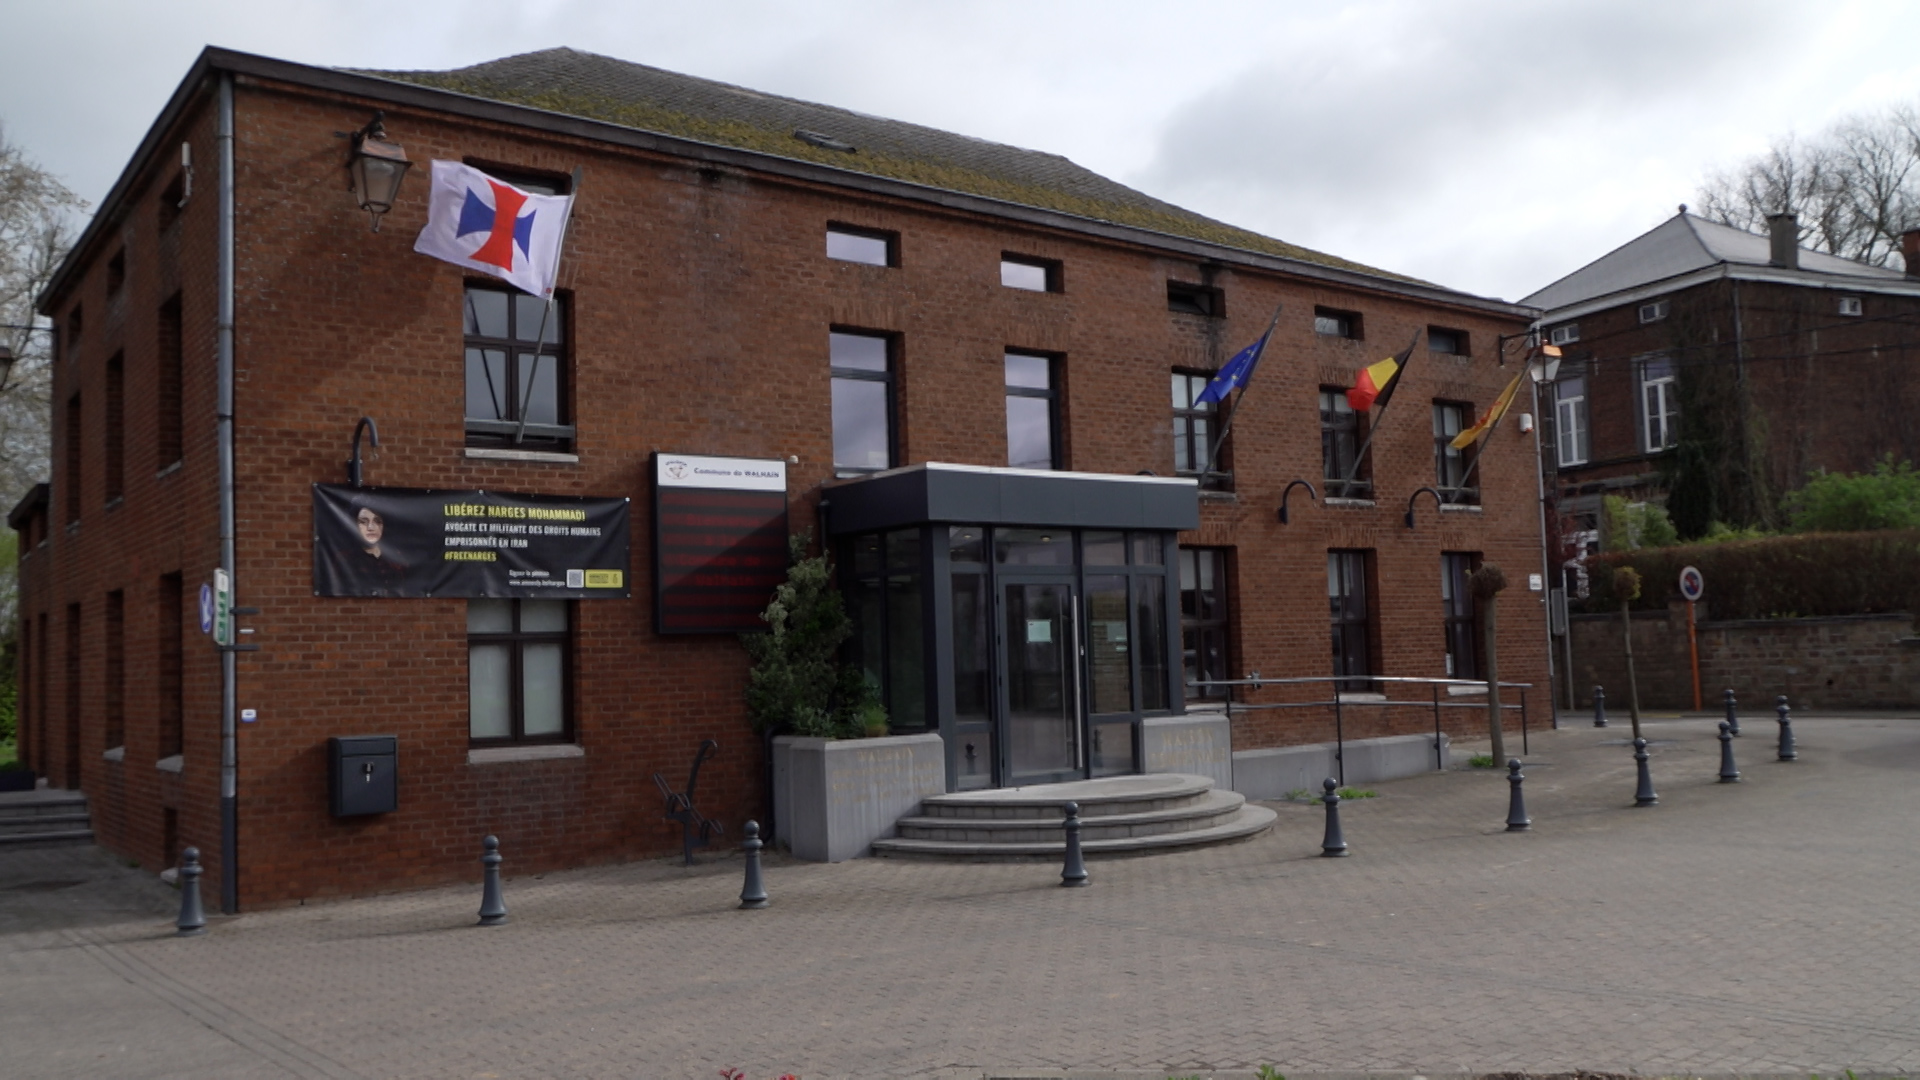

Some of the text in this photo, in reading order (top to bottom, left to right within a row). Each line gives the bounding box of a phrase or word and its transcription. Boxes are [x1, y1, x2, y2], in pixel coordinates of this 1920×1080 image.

[694, 467, 731, 476] Commune
[745, 470, 779, 478] WALHAIN
[444, 502, 586, 521] LIBÉREZ NARGES MOHAMMADI
[444, 522, 601, 536] AVOCATE ET MILITANTE DES DROITS HUMAINS
[444, 535, 528, 548] EMPRISONNÉE EN IRAN
[444, 550, 497, 561] #FREENARGES
[695, 574, 755, 586] Walhain
